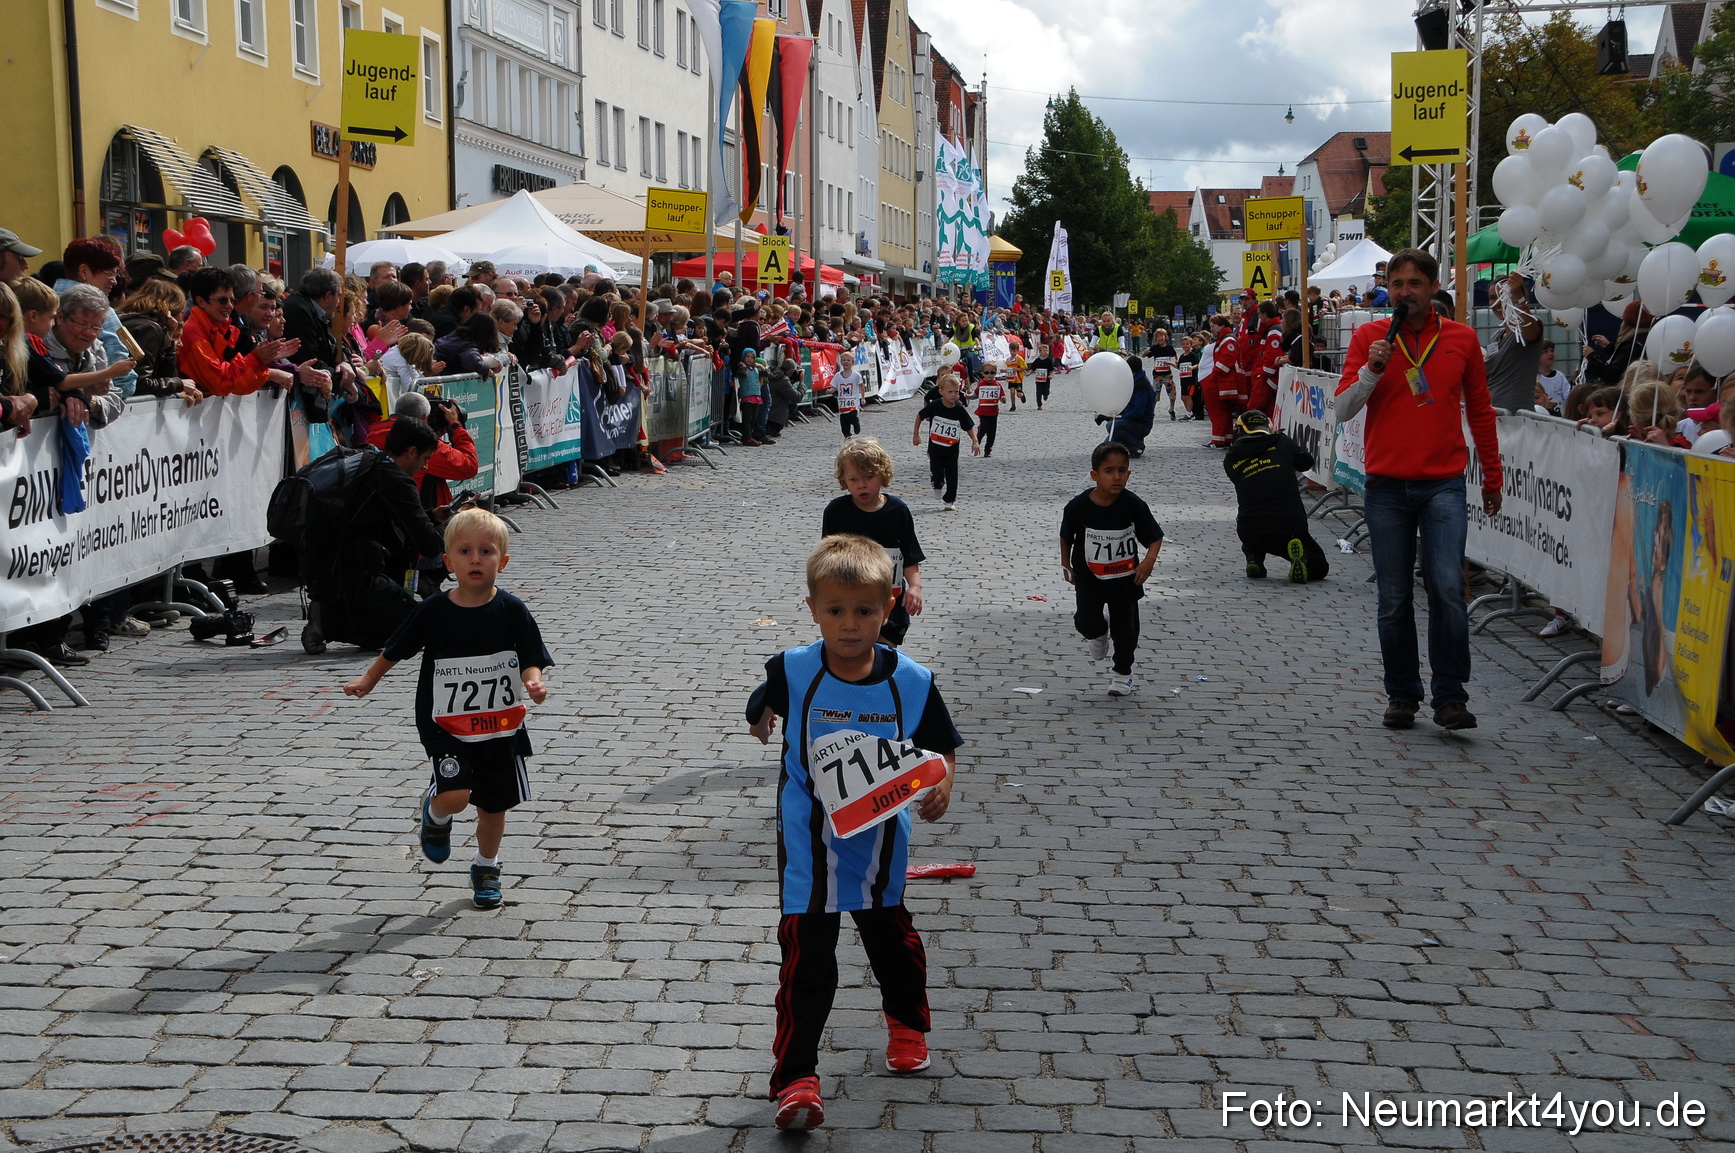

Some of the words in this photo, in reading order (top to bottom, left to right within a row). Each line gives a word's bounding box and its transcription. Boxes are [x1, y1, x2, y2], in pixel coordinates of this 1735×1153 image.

[346, 59, 416, 83] Jugend-
[365, 82, 397, 101] lauf
[1394, 80, 1464, 103] Jugend-
[1413, 102, 1446, 120] lauf
[650, 199, 702, 212] Schnupper-
[667, 213, 685, 222] lauf
[1248, 210, 1300, 220] Schnupper-
[1266, 221, 1283, 231] lauf
[762, 237, 786, 247] Block
[1338, 232, 1363, 241] swn
[764, 250, 782, 273] A
[1246, 252, 1271, 262] Block
[1053, 276, 1061, 287] B
[1250, 265, 1268, 289] A
[981, 390, 998, 398] 7145
[934, 422, 957, 437] 7143
[81, 438, 219, 511] fficientDynamics
[7, 538, 76, 581] Weniger
[131, 509, 158, 540] Mehr
[1092, 537, 1138, 561] 7140
[435, 667, 463, 677] PARTL
[465, 661, 505, 675] Neumarkt
[444, 675, 515, 713] 7273
[471, 716, 498, 732] Phil
[871, 783, 911, 814] Joris
